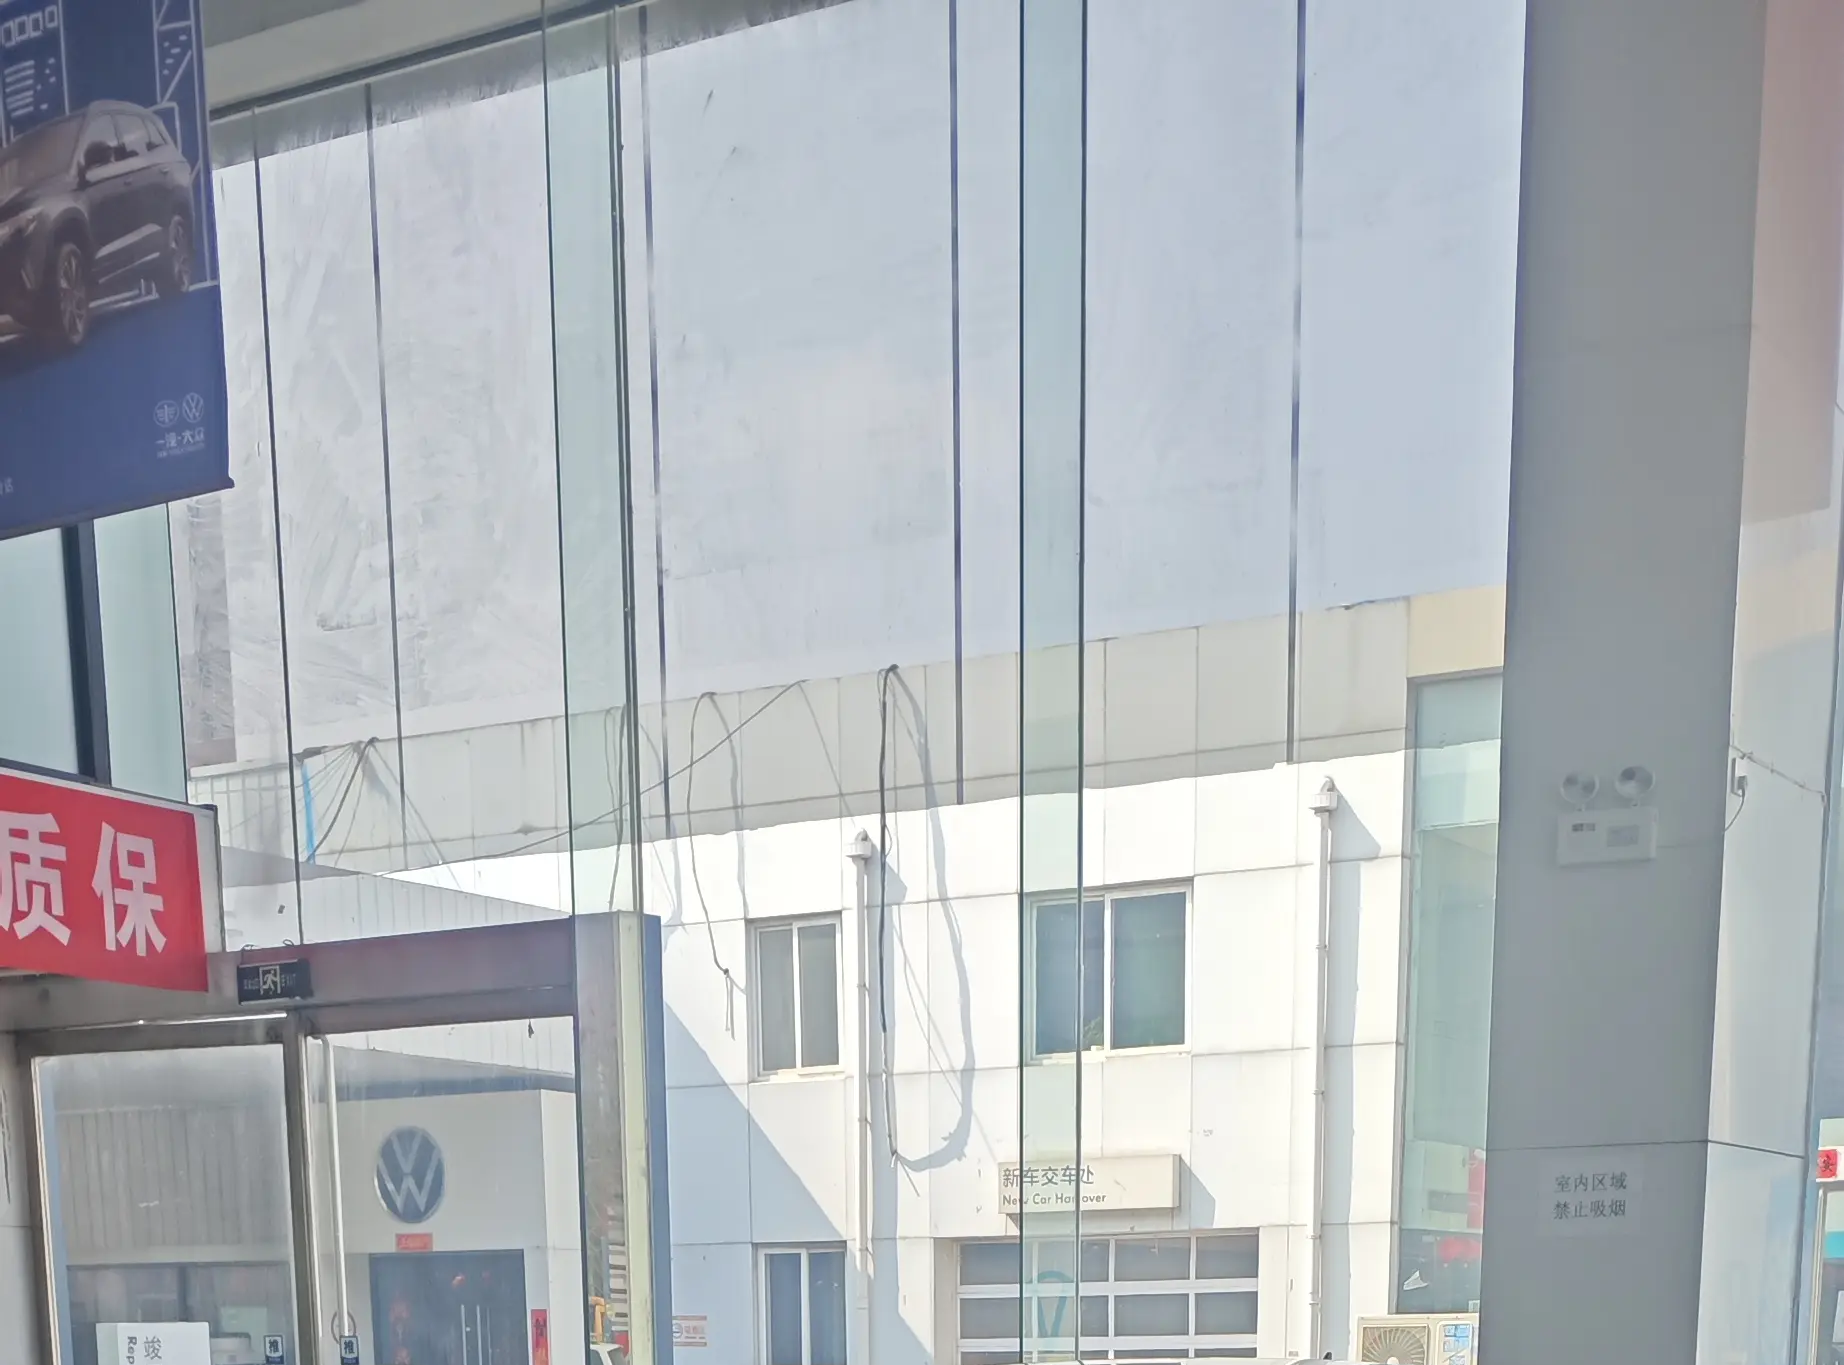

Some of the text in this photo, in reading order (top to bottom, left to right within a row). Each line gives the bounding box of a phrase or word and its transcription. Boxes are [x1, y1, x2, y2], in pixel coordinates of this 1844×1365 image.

[0, 812, 167, 957] 质保
[1003, 1165, 1094, 1187] 新车交车处
[1554, 1172, 1628, 1192] 室内区域
[1033, 1193, 1051, 1205] Car
[1552, 1199, 1626, 1220] 禁止吸烟
